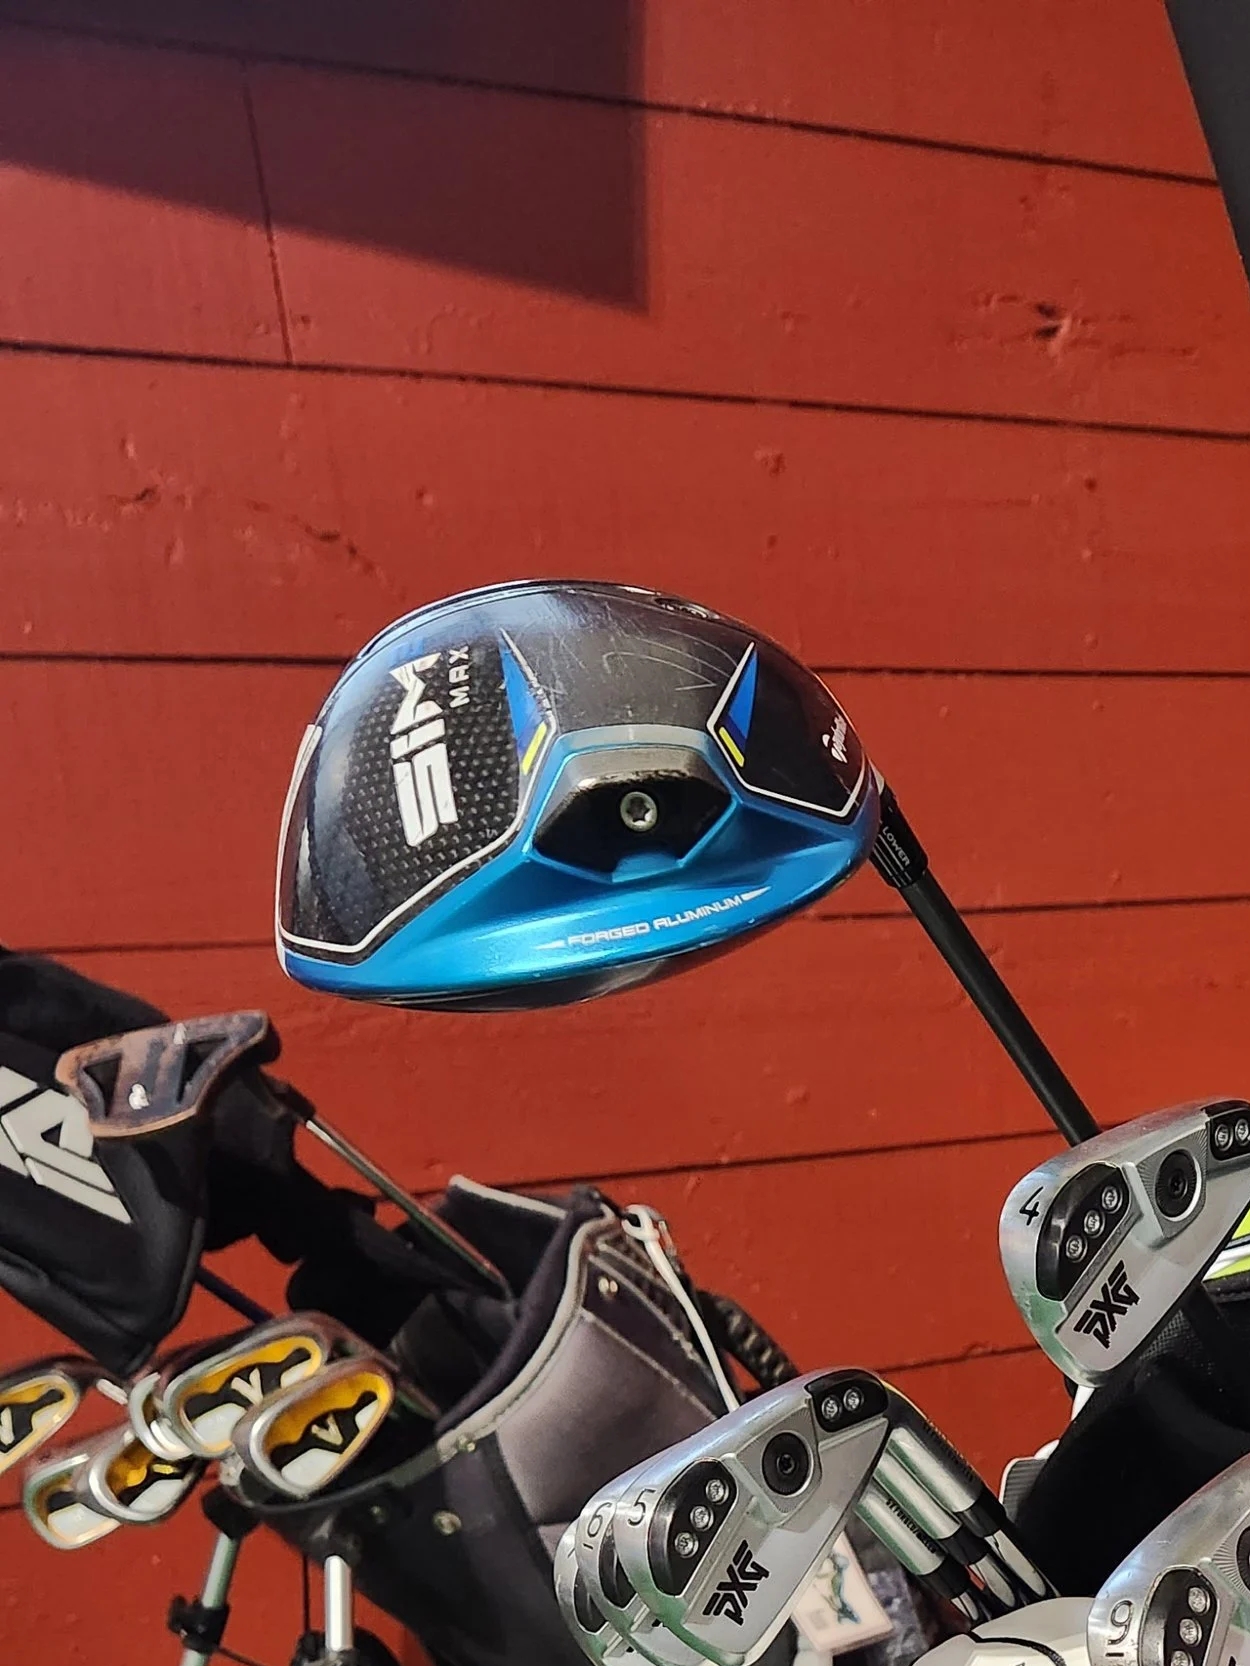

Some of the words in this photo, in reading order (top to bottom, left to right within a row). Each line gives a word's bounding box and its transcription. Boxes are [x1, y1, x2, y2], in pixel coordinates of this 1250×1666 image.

[449, 646, 470, 708] MAX
[882, 826, 911, 867] LOWER
[568, 922, 650, 946] FORGED
[653, 895, 742, 930] ALUMINUM
[1019, 1186, 1044, 1226] 4
[1073, 1259, 1140, 1349] PXG
[586, 1502, 613, 1537] 6
[627, 1488, 656, 1526] 5
[702, 1539, 770, 1626] PXG
[1107, 1600, 1133, 1645] 9
